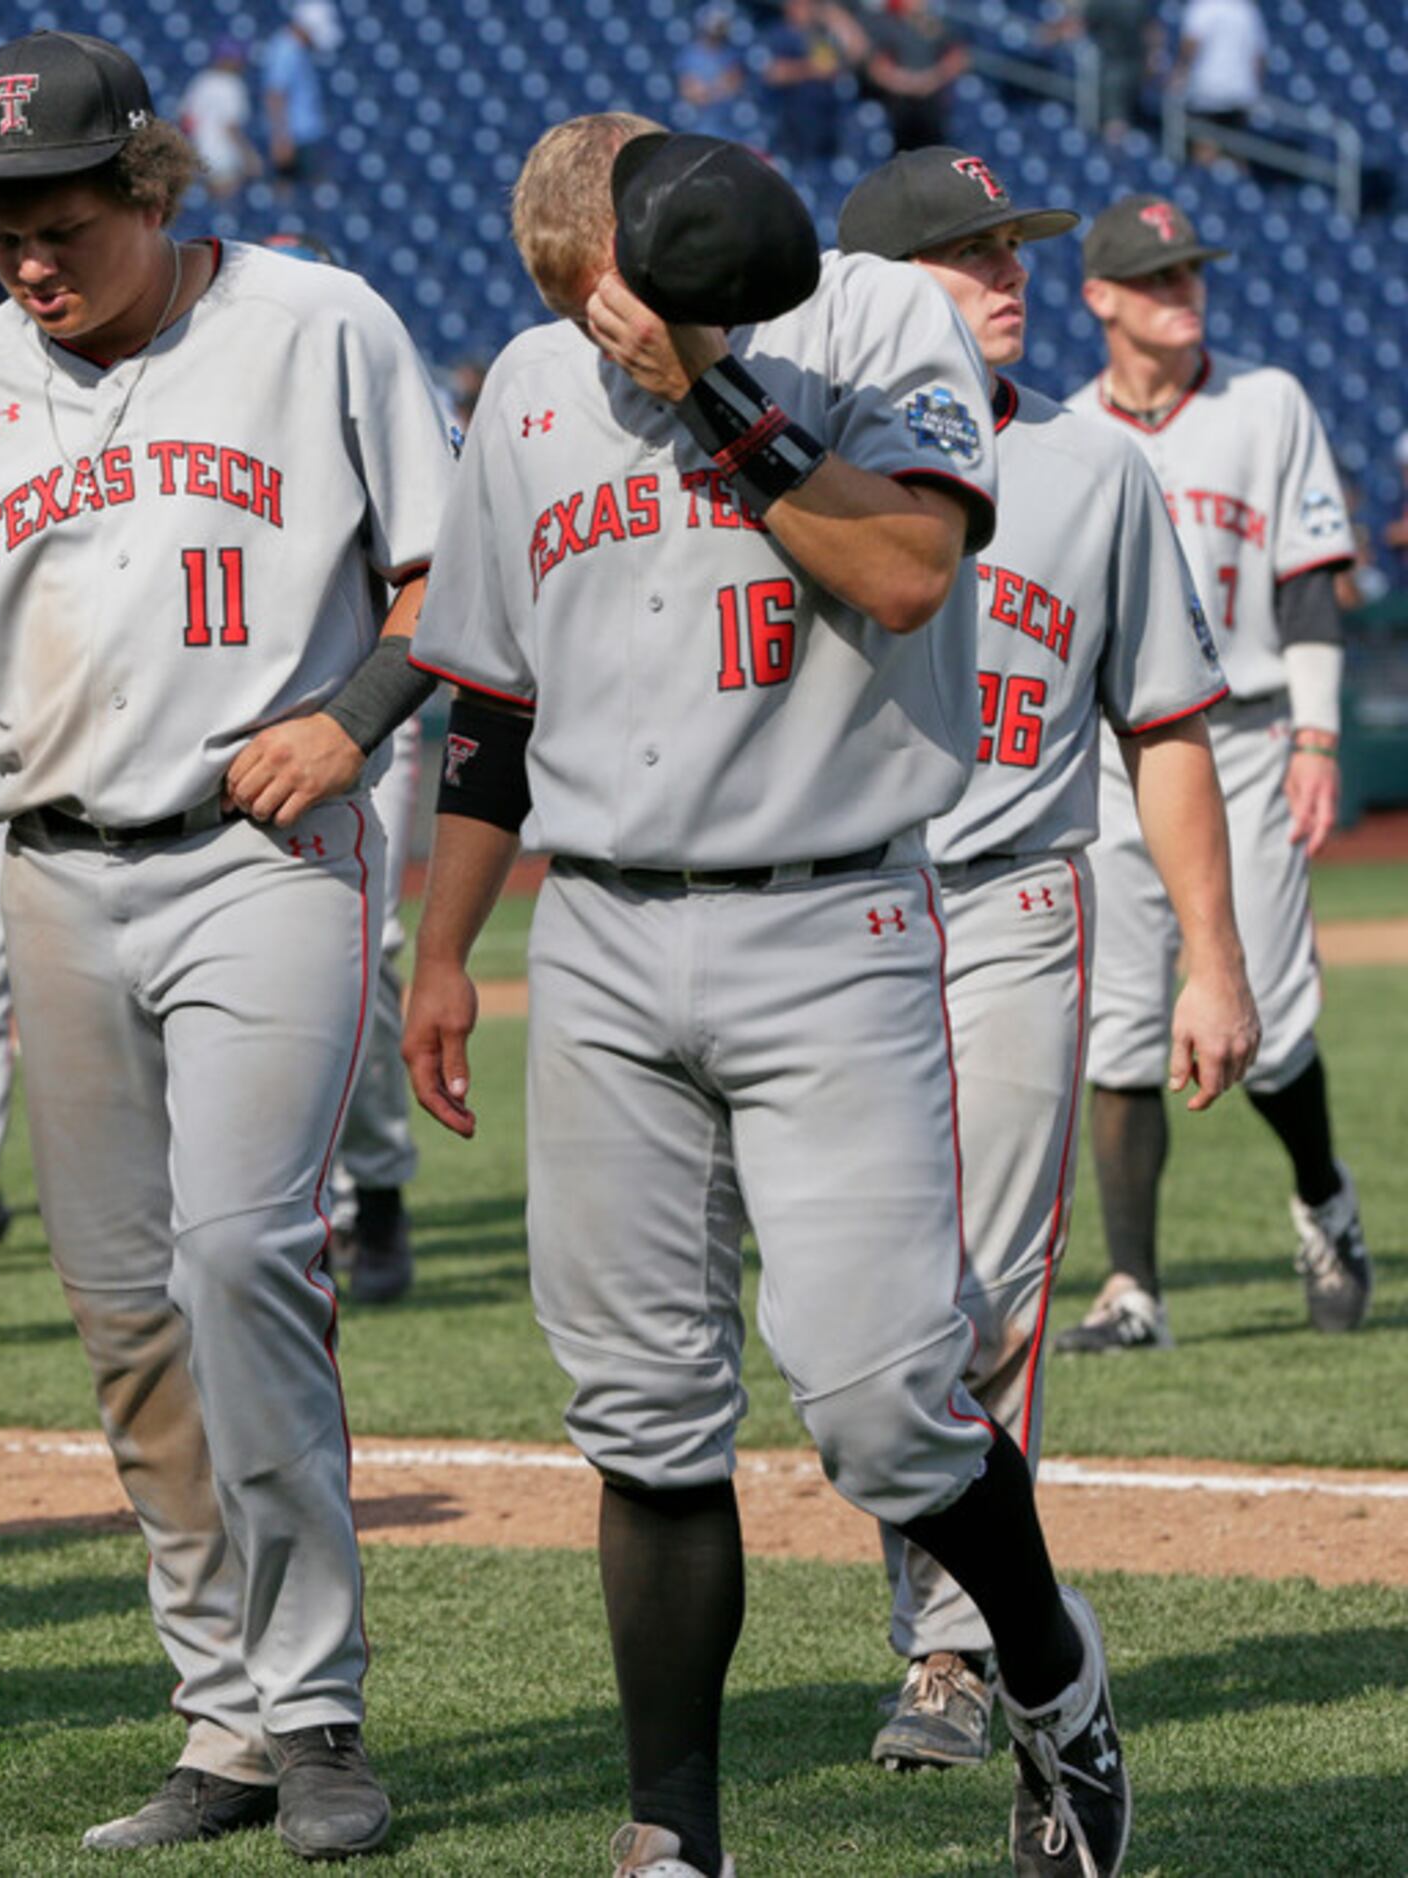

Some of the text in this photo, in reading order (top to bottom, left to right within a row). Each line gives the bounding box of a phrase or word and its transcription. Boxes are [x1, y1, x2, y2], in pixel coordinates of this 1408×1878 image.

[147, 440, 284, 529] TECH
[679, 469, 770, 533] TE
[181, 547, 250, 647] 11
[716, 577, 795, 692] 16
[1217, 565, 1240, 631] 7
